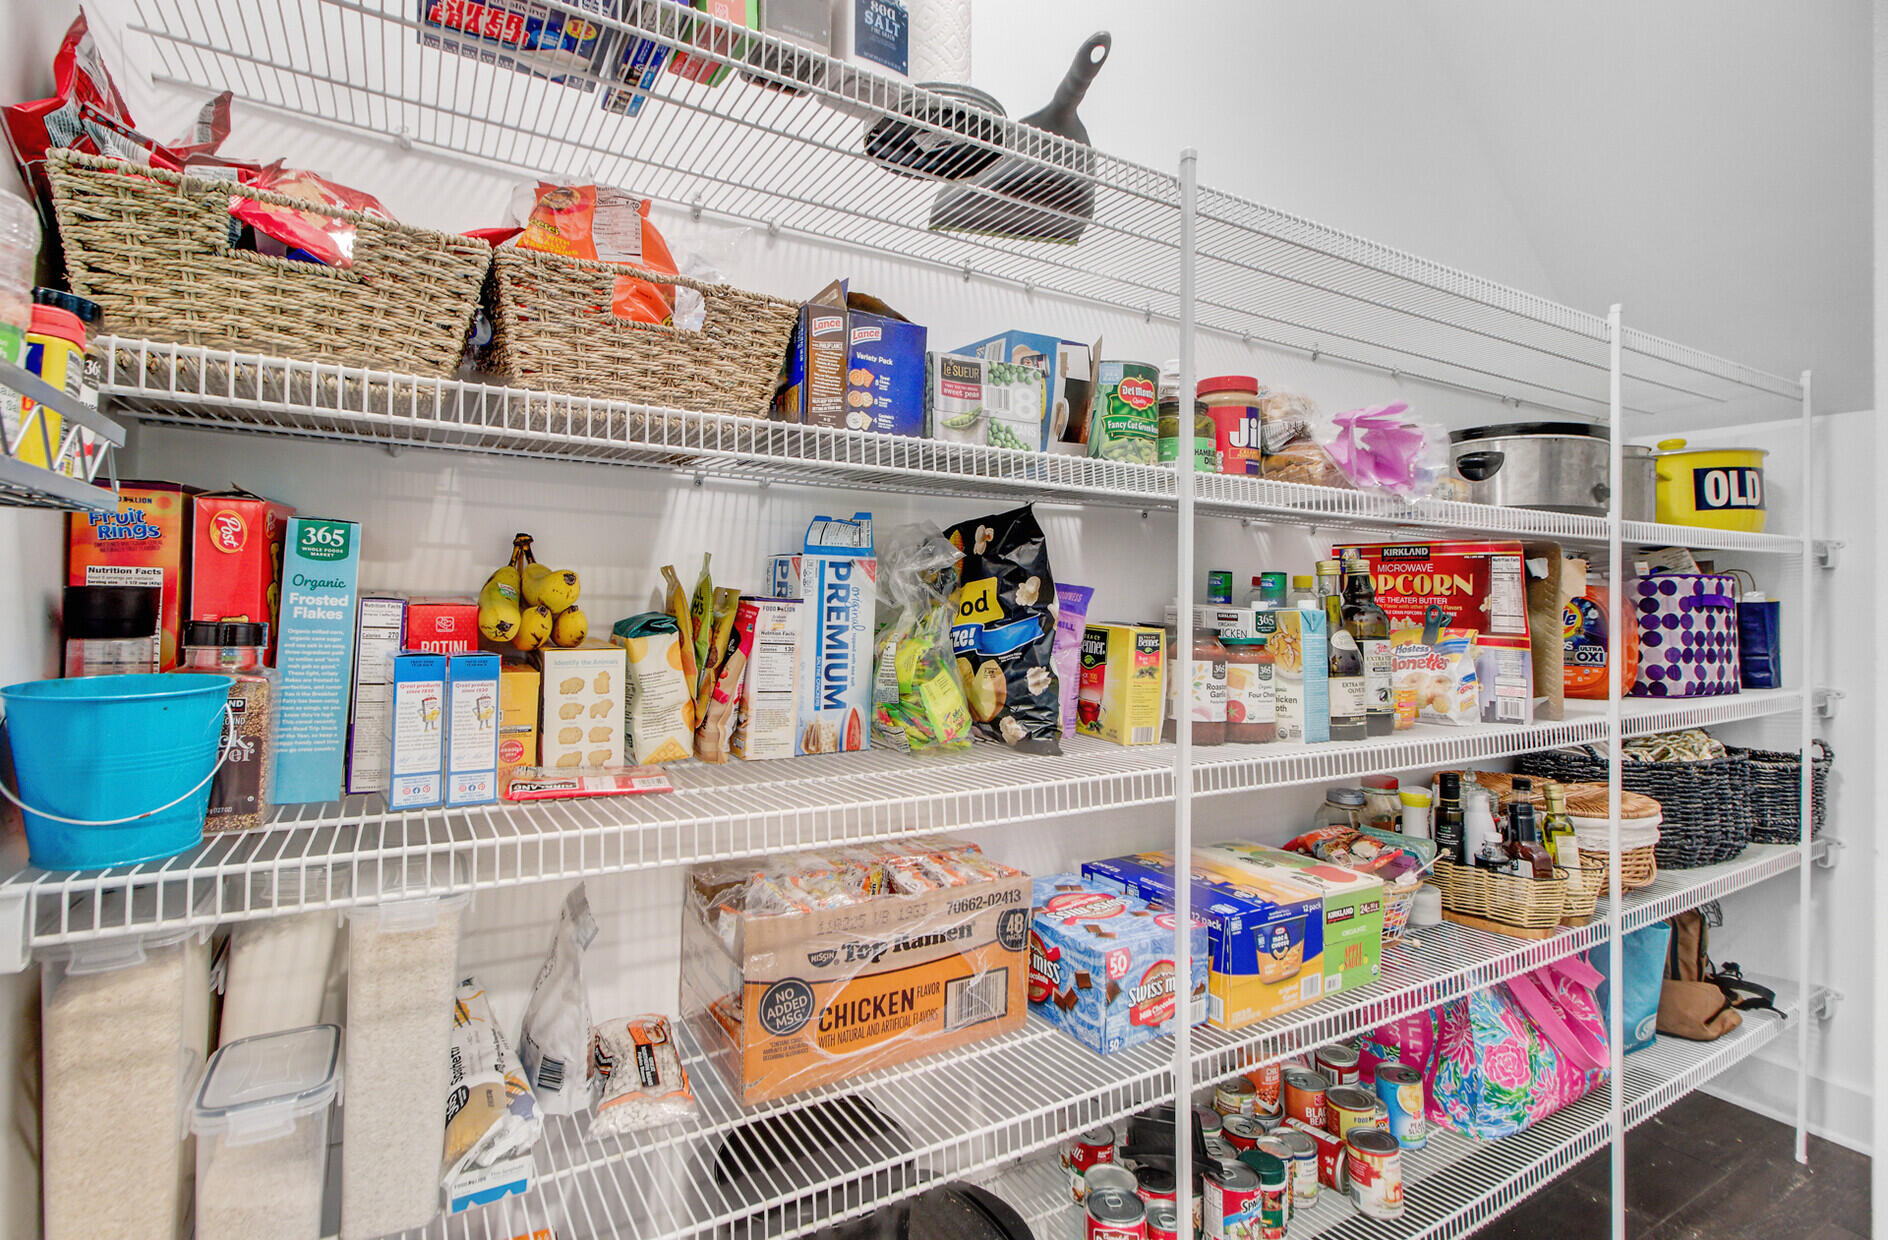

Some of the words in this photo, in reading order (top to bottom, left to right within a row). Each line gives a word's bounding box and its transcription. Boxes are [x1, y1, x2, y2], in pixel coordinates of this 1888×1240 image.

[864, 10, 900, 37] SALT
[813, 318, 841, 331] Lance
[852, 329, 880, 341] Lance
[856, 351, 878, 363] Variety
[878, 356, 893, 366] Pack
[952, 365, 979, 379] SUEUR
[1122, 385, 1135, 396] Del
[1135, 386, 1154, 399] Monte
[1107, 420, 1126, 431] Fancy
[1127, 420, 1138, 429] Cut
[1704, 470, 1762, 507] OLD
[88, 507, 145, 526] Fruit
[97, 523, 162, 540] Rings
[215, 511, 240, 547] Post
[301, 526, 346, 548] 365
[1383, 548, 1428, 556] KIRKLAND
[88, 567, 132, 575] Nutrition
[135, 568, 162, 576] Facts
[1377, 563, 1434, 573] MICROWAVE
[292, 573, 346, 591] Organic
[1369, 573, 1474, 596] PCORN
[289, 592, 349, 607] Frosted
[1419, 597, 1447, 605] BUTTER
[293, 606, 344, 620] Flakes
[1257, 615, 1275, 626] 365
[823, 561, 851, 710] PREMIUM
[1221, 628, 1248, 638] ICKEN
[1394, 644, 1430, 656] Hostess
[1576, 651, 1604, 663] OXI
[946, 888, 1022, 916] 70662-02413
[1302, 903, 1309, 913] 12
[1309, 902, 1322, 913] pack
[1005, 913, 1024, 936] 48
[841, 941, 888, 964] Top
[1110, 953, 1128, 976] 50
[776, 987, 795, 1004] NO
[767, 995, 808, 1021] ADDED
[818, 987, 915, 1032] CHICKEN
[916, 982, 941, 999] FLAVOR
[775, 1011, 803, 1029] MSG
[818, 1033, 836, 1048] WITH
[837, 1027, 866, 1044] NATURAL
[866, 1023, 880, 1038] AND
[881, 1015, 912, 1034] ARTIFICIAL
[912, 1007, 939, 1026] FLAVORS
[1109, 1038, 1121, 1051] 50
[1407, 1019, 1423, 1062] ILLY
